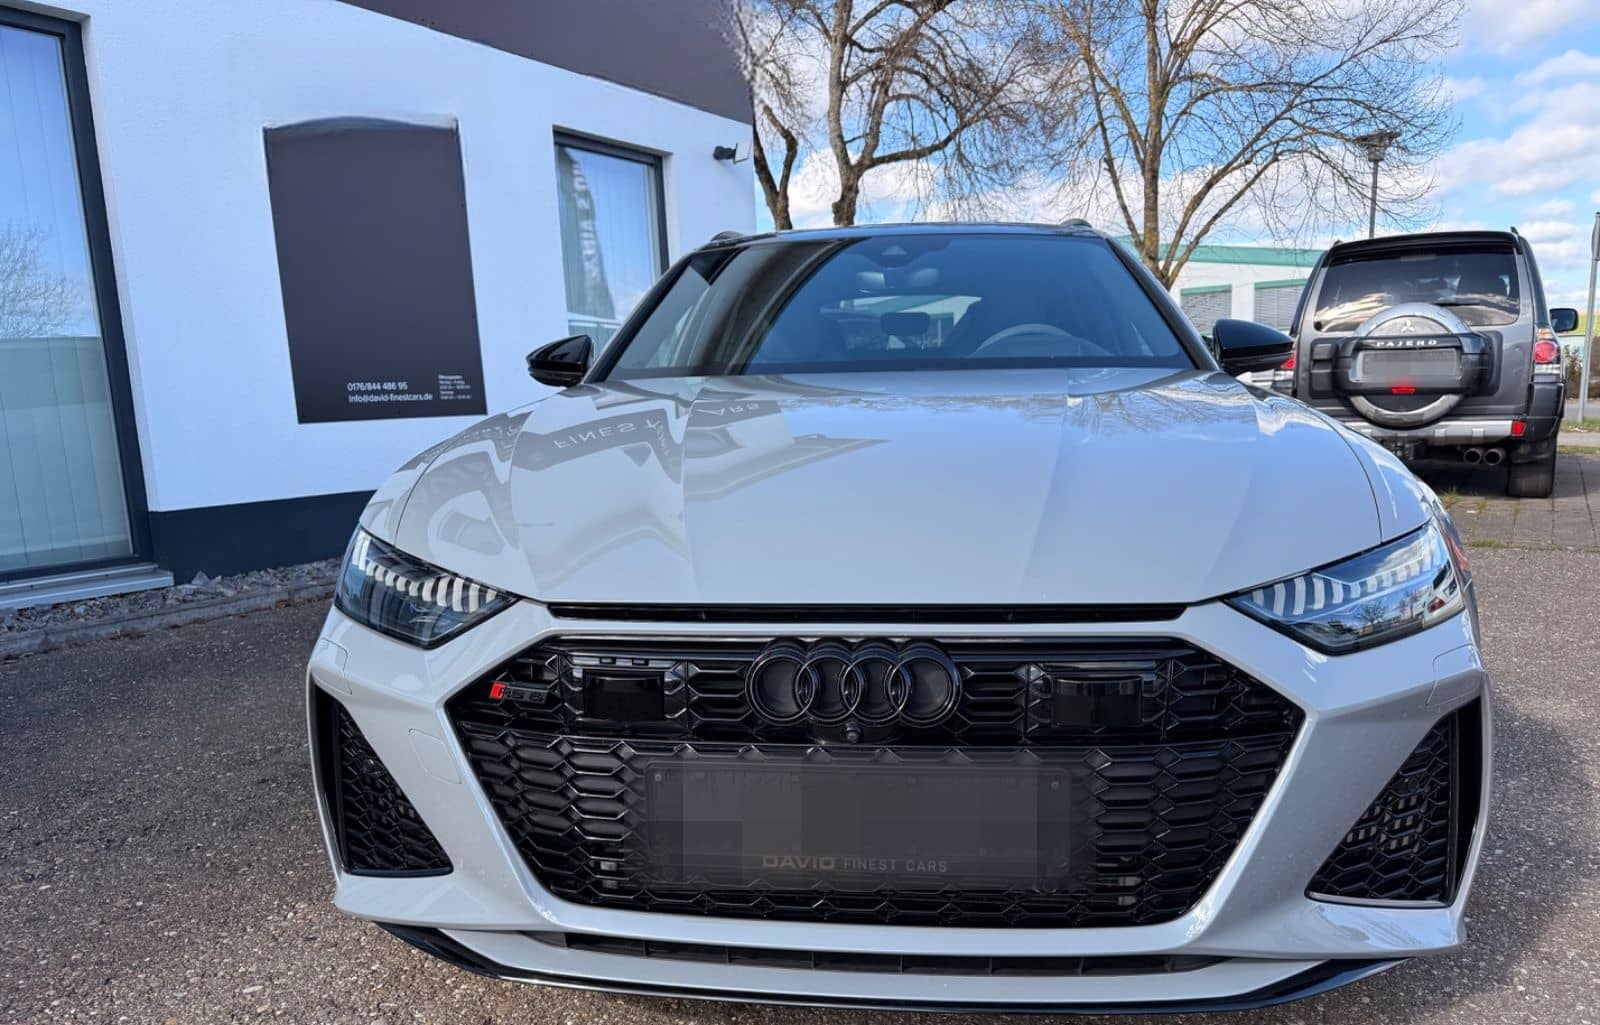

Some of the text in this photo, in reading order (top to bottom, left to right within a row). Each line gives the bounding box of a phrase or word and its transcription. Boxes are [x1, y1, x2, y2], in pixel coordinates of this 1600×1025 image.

[1376, 340, 1437, 348] PAJERO
[398, 381, 408, 391] 95
[761, 855, 948, 873] DAVID FINEST CARS
